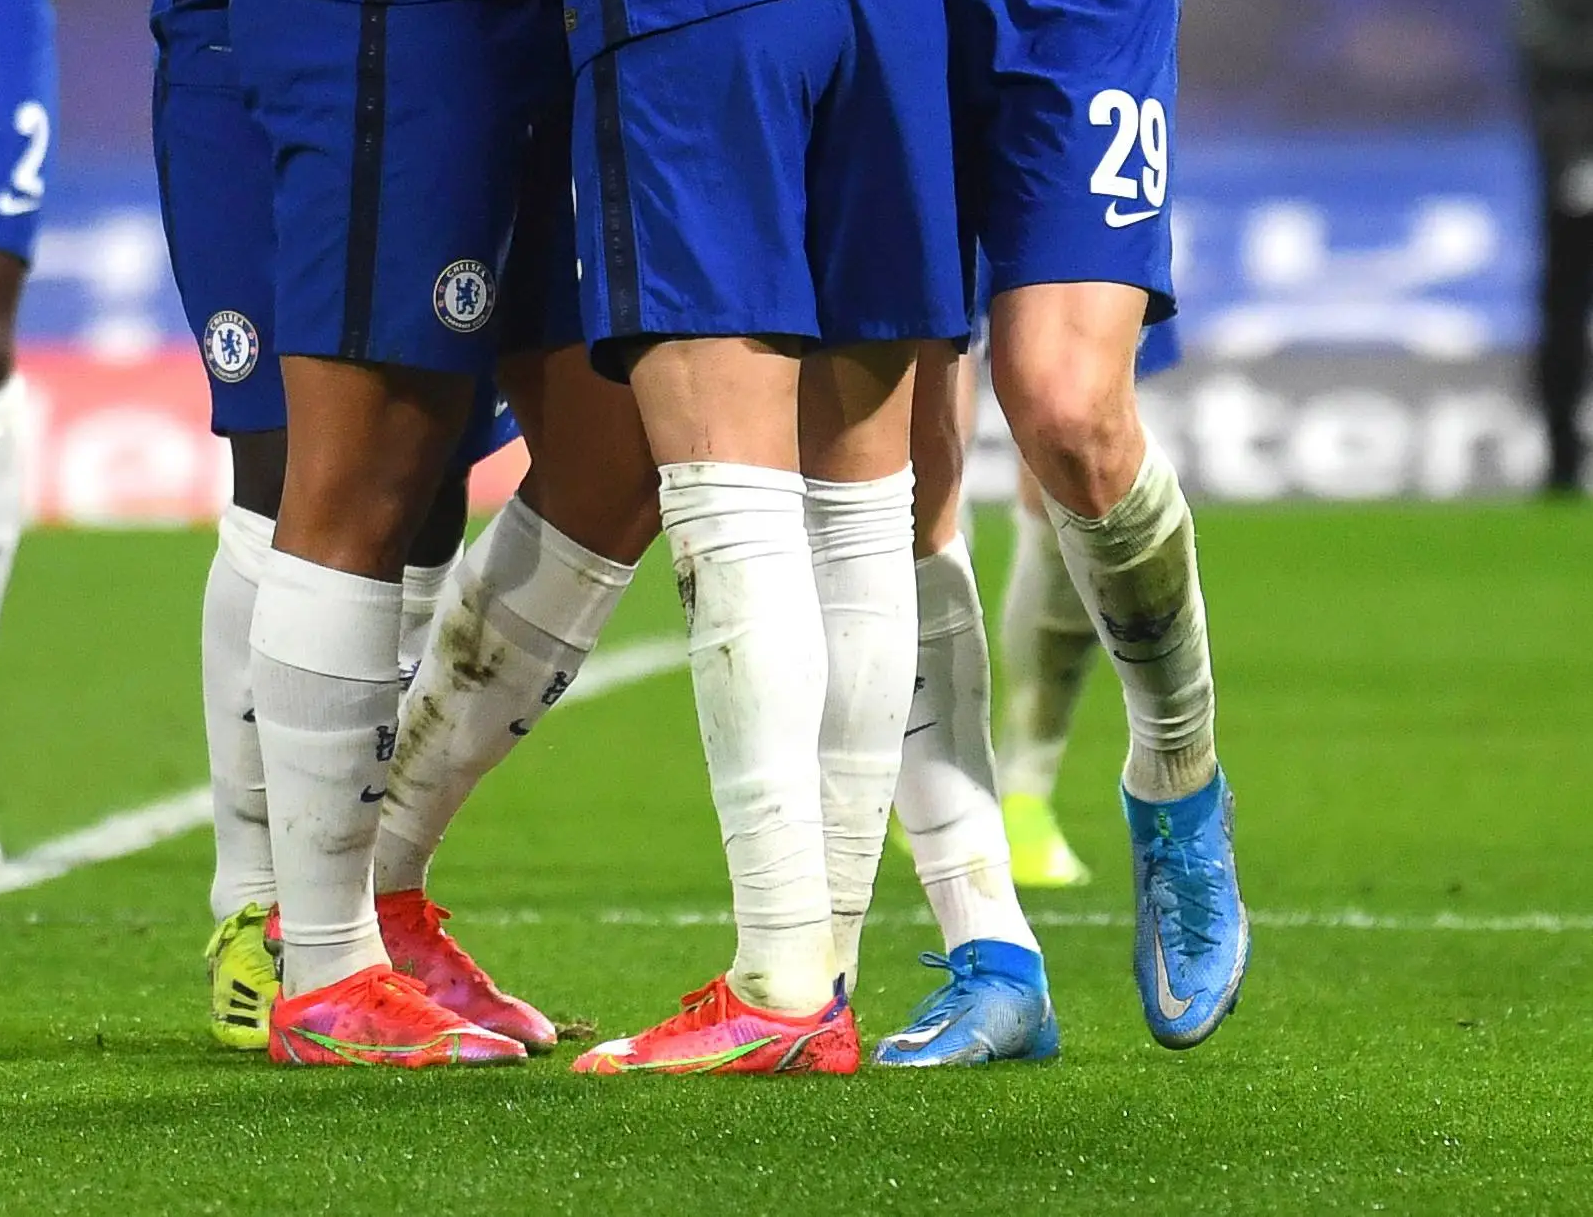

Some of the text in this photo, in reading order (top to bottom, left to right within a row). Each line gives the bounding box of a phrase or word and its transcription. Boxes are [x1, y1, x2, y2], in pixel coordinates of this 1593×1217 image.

[12, 101, 50, 198] 2
[1088, 88, 1168, 208] 29
[447, 263, 485, 278] CHELSEA
